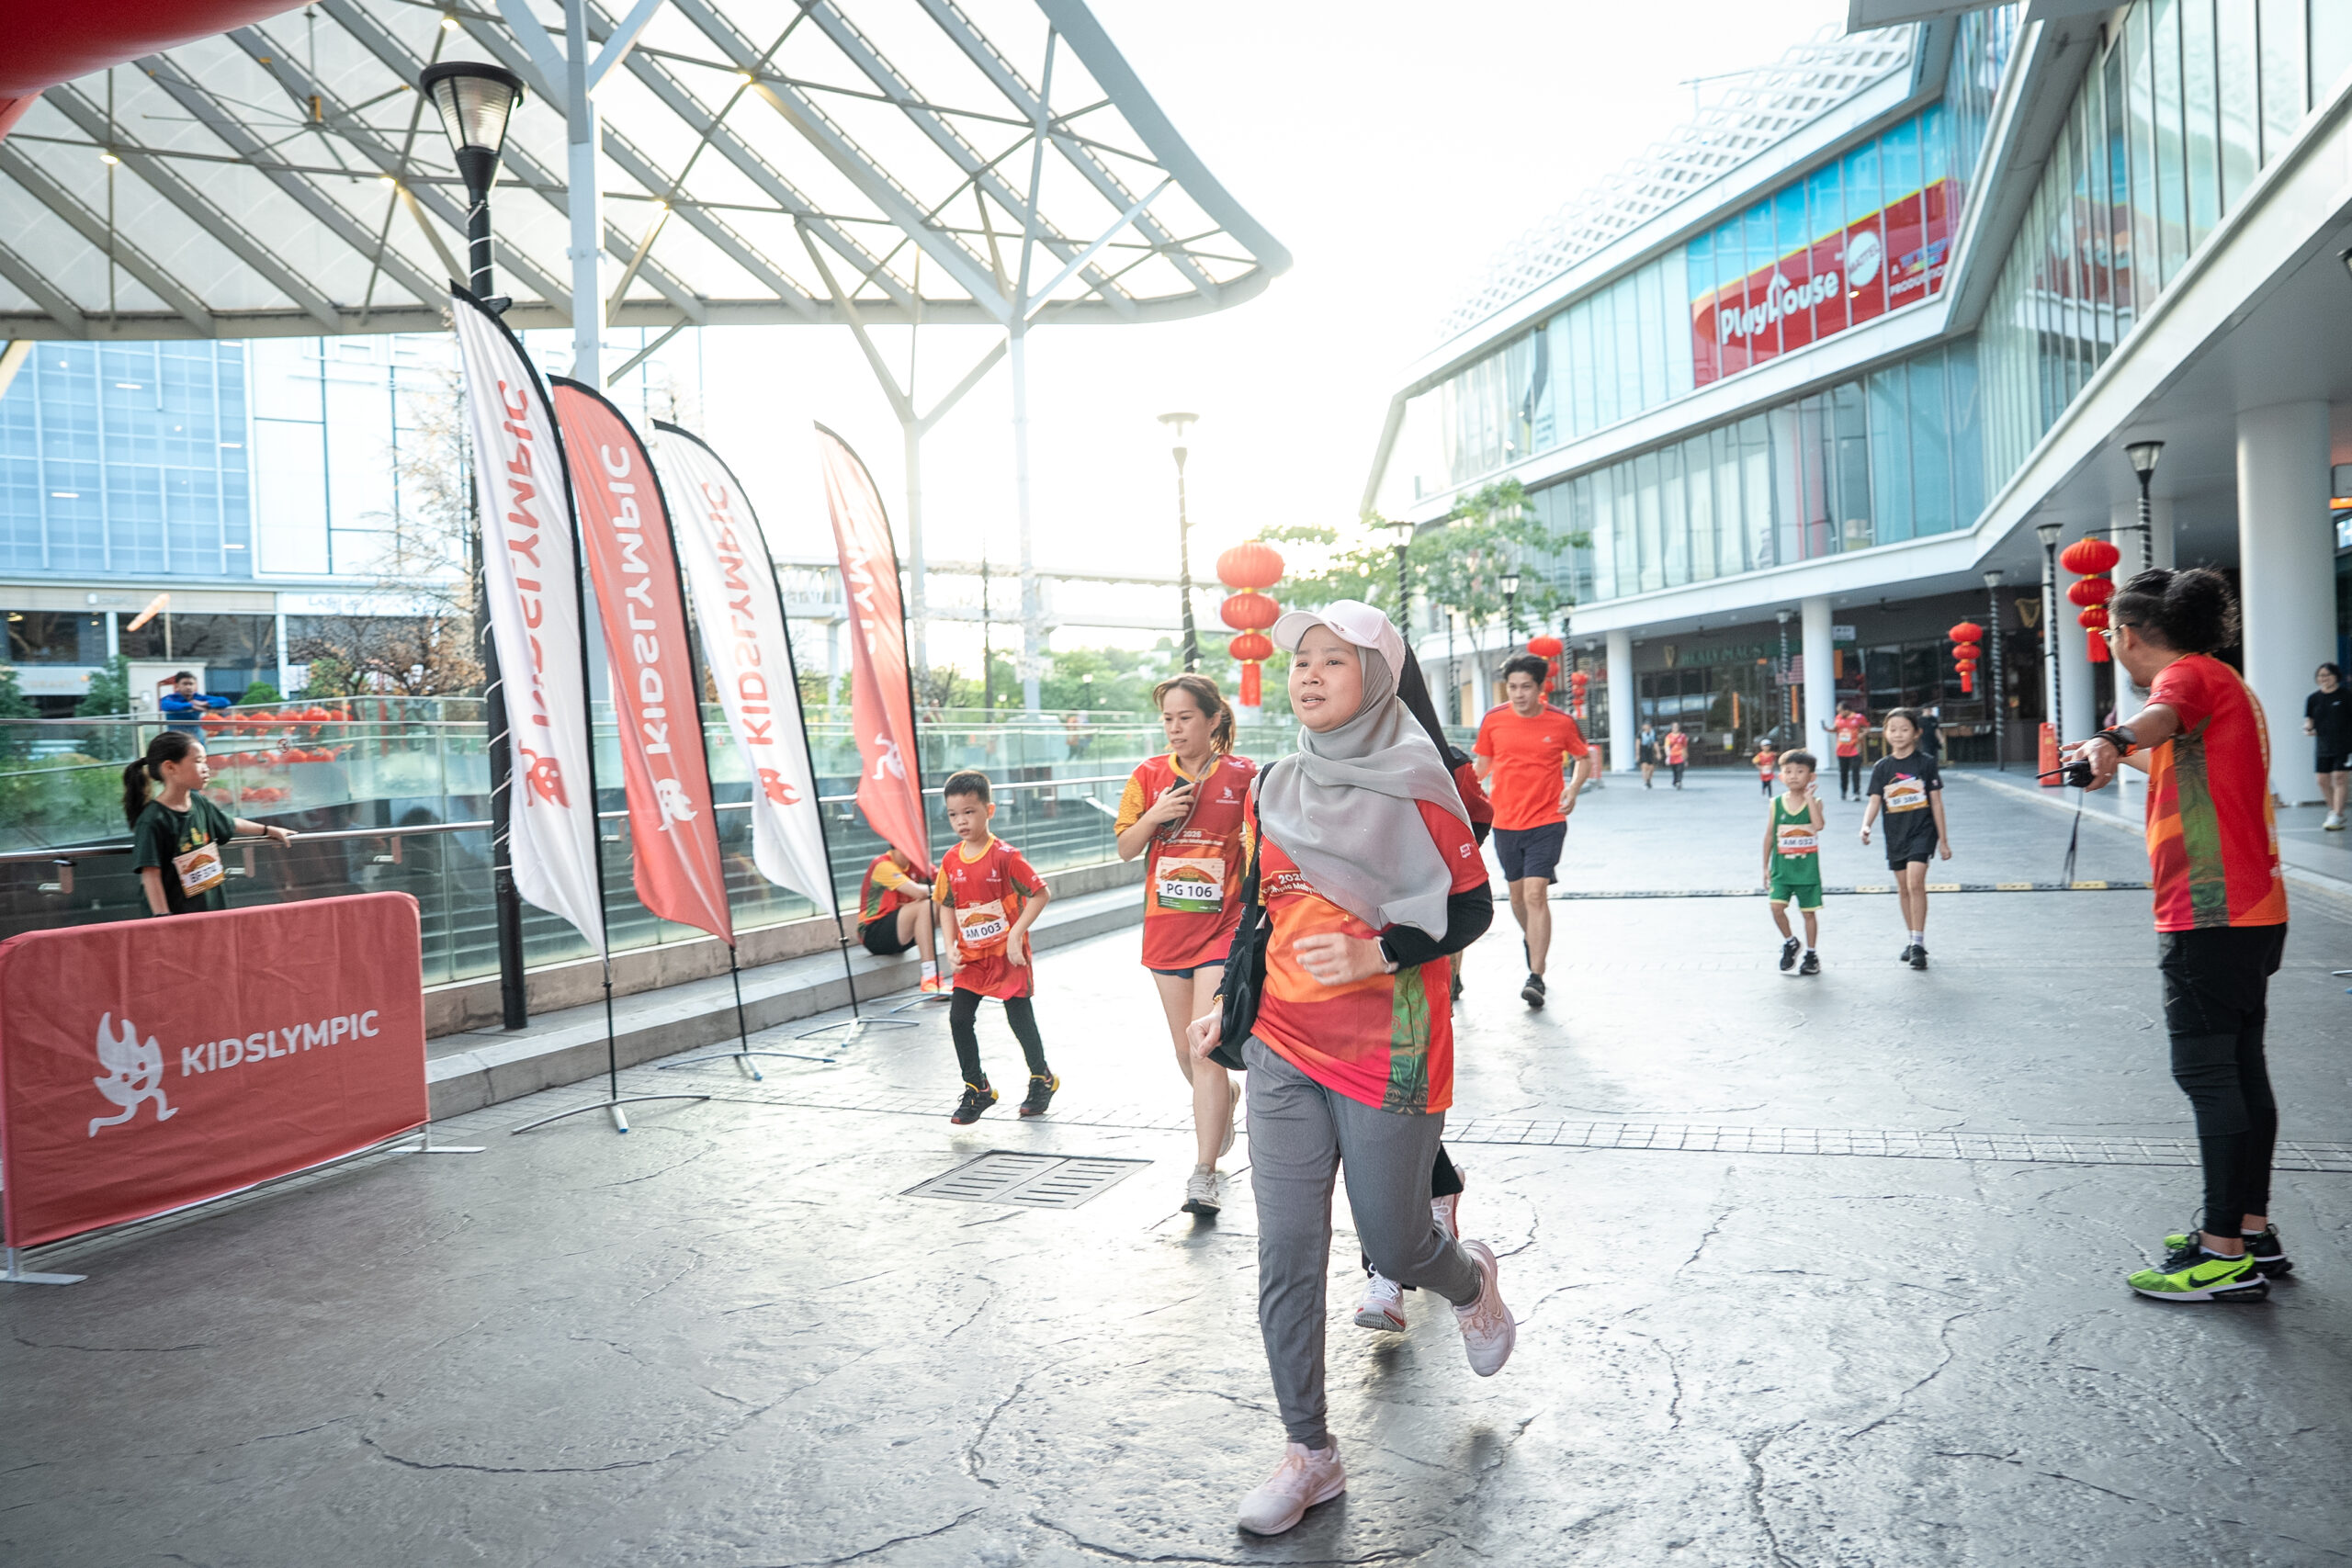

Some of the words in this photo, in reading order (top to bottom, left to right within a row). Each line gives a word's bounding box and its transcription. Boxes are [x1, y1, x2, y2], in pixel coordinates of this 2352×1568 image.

[1889, 264, 1949, 297] PRODUCIO
[1167, 883, 1183, 896] PG
[1187, 886, 1213, 897] 106
[966, 929, 979, 939] AM
[980, 922, 1001, 936] 003
[181, 1010, 380, 1077] KIDSLYMPIC
